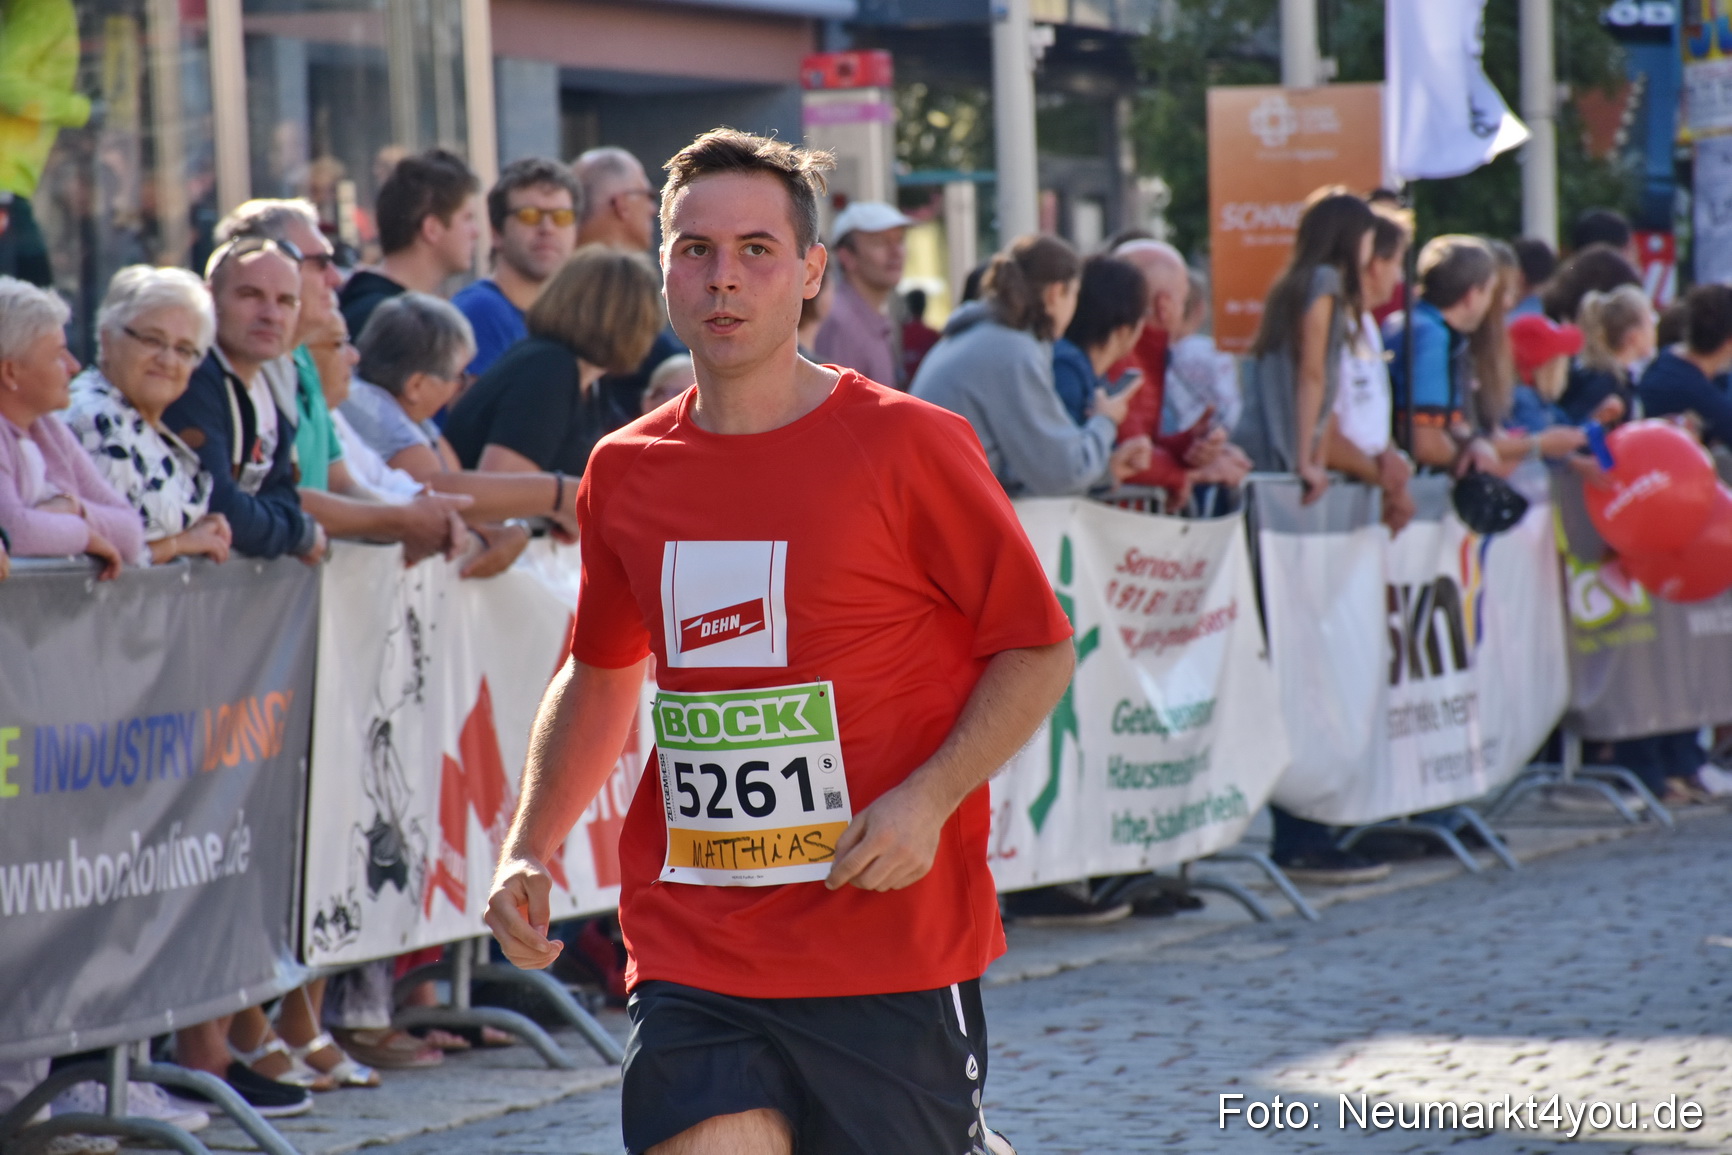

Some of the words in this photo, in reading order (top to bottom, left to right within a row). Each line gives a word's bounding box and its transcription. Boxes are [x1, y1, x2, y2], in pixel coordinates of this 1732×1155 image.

[700, 613, 741, 638] DEHN
[661, 696, 814, 741] BOCK
[34, 711, 197, 795] INDUSTRY
[823, 758, 833, 769] S
[674, 757, 815, 819] 5261
